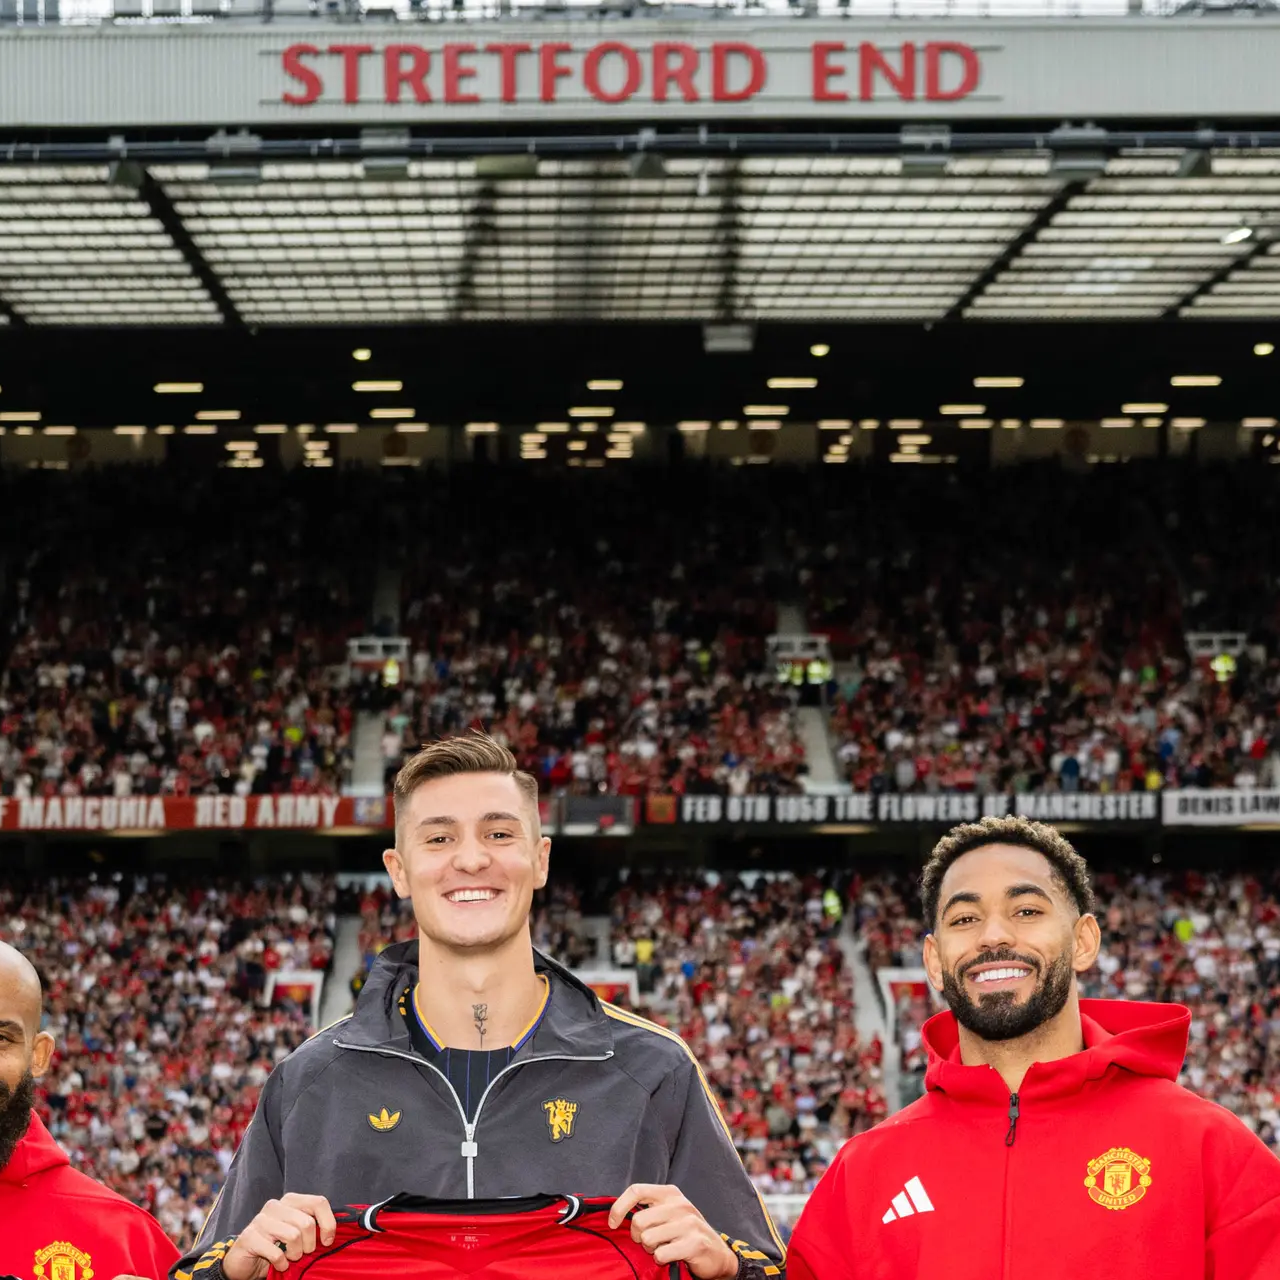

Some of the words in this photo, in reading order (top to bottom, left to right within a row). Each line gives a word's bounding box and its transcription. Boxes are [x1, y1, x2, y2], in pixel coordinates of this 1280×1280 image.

[281, 41, 767, 105] STRETFORD
[811, 41, 981, 102] END
[835, 793, 875, 821] THE
[878, 793, 979, 821] FLOWERS
[982, 792, 1010, 819] OF
[1015, 792, 1160, 821] MANCHESTER
[1178, 796, 1233, 815] DENIS
[1240, 796, 1280, 814] LAW
[1091, 1151, 1145, 1172] MANCHESTER
[1098, 1194, 1136, 1205] UNITED
[39, 1245, 88, 1267] MANCHESTER
